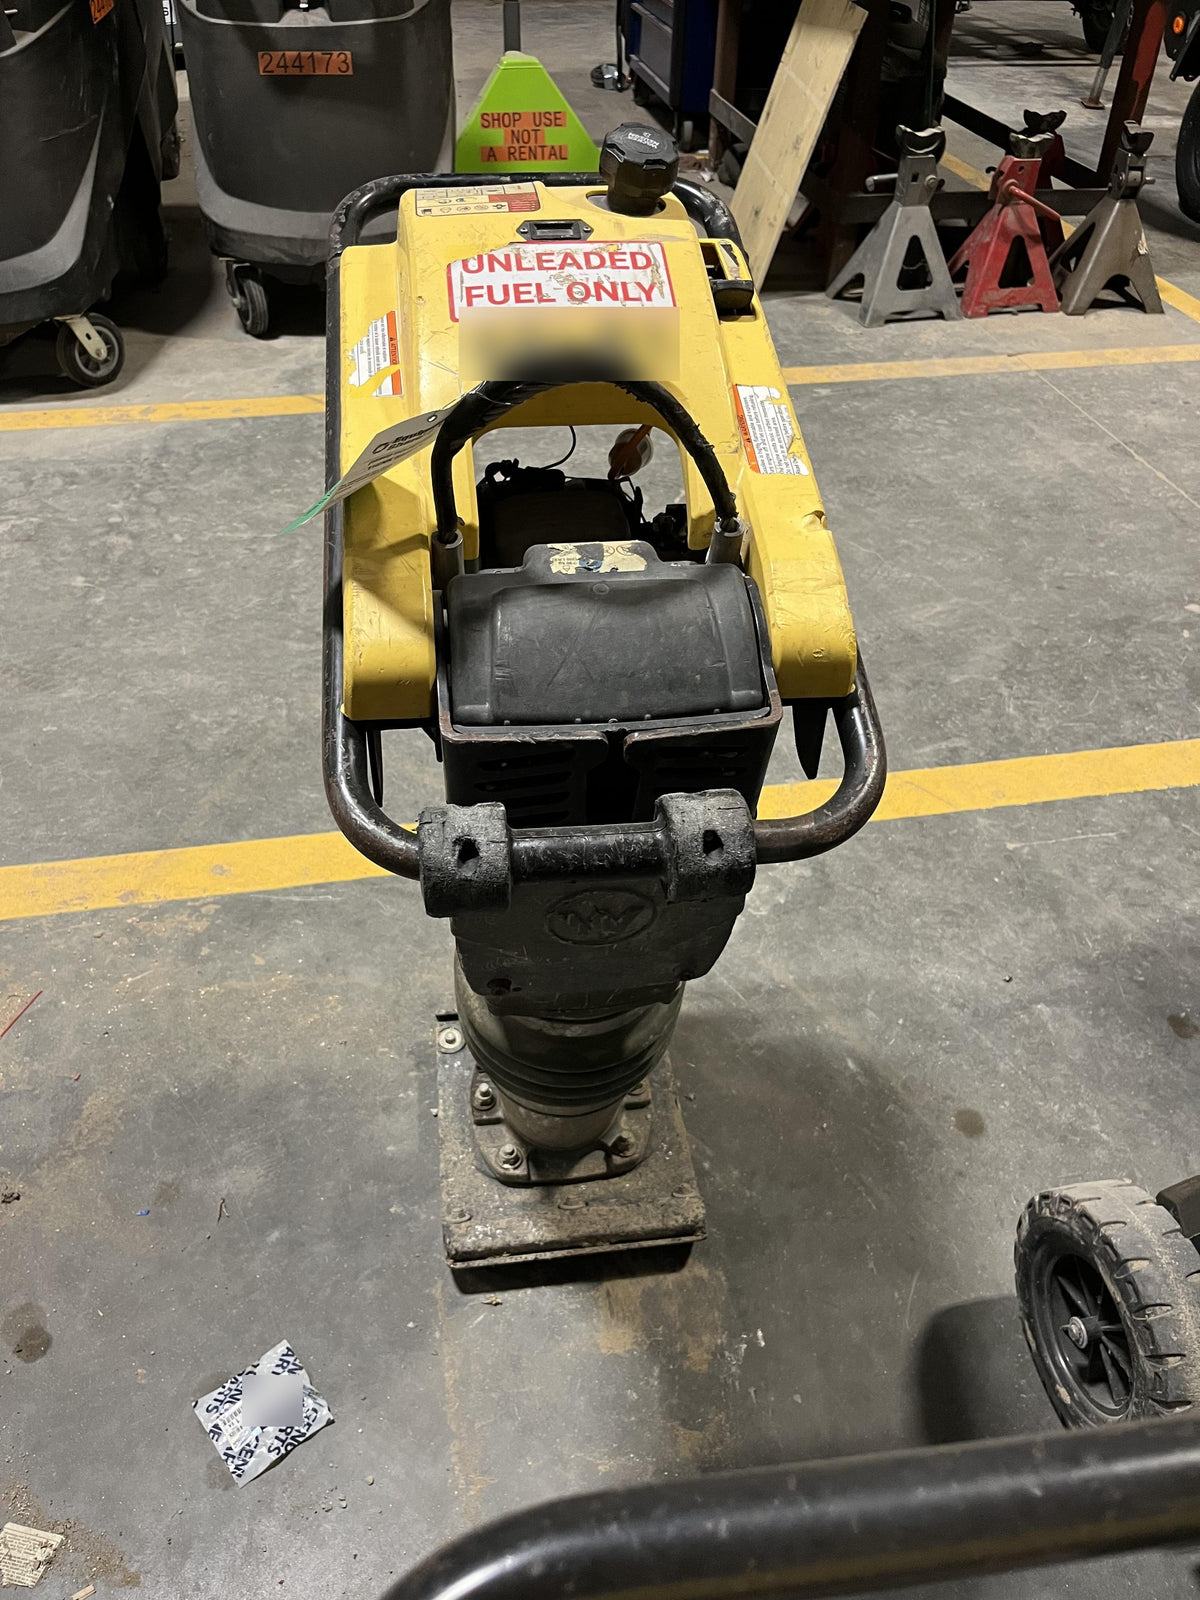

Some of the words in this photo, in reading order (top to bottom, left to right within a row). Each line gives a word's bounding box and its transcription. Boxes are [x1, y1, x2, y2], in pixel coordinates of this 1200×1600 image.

[260, 52, 350, 74] 244173
[481, 112, 522, 128] SHOP
[533, 111, 563, 127] USE
[511, 129, 541, 144] NOT
[487, 146, 498, 162] A
[508, 145, 568, 161] RENTAL
[461, 251, 653, 274] UNLEADED
[465, 282, 556, 307] FUEL
[566, 281, 657, 302] ONLY
